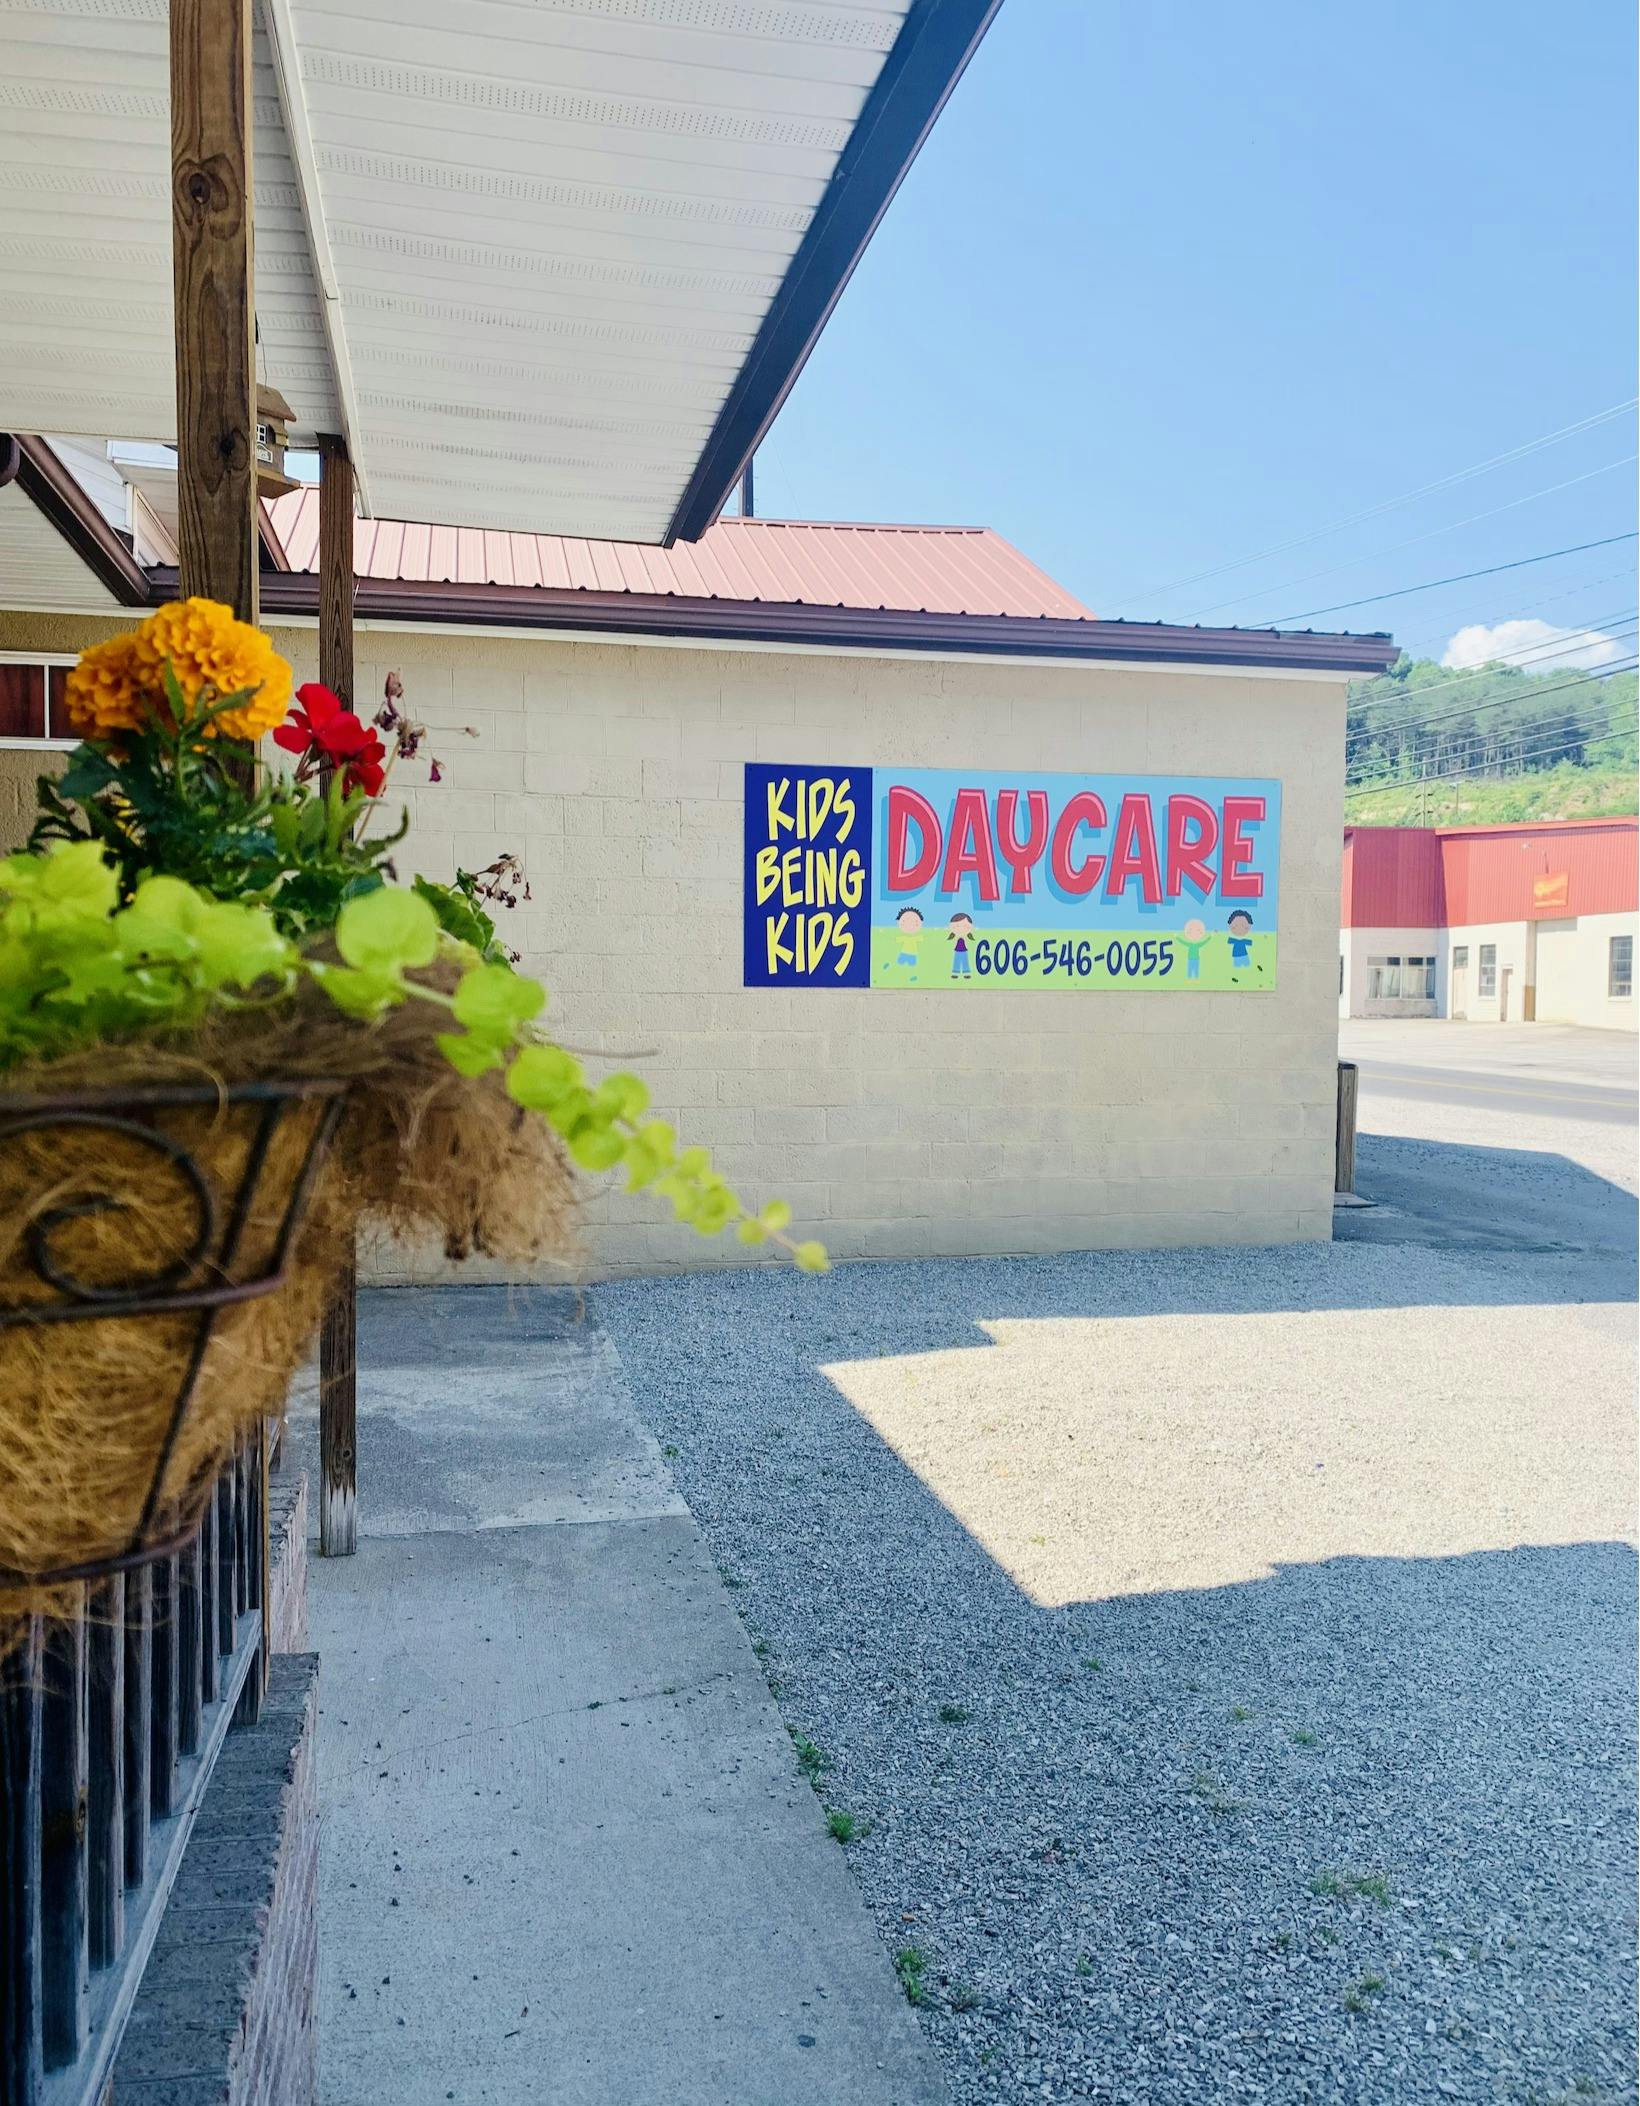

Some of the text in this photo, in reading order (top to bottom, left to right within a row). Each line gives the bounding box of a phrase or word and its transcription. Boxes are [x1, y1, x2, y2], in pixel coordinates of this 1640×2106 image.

[767, 777, 856, 844] KIDS
[887, 785, 1266, 904] DAYCARE
[756, 846, 865, 909] BEING
[765, 911, 855, 976] KIDS
[975, 939, 1174, 978] 606-546-0055
